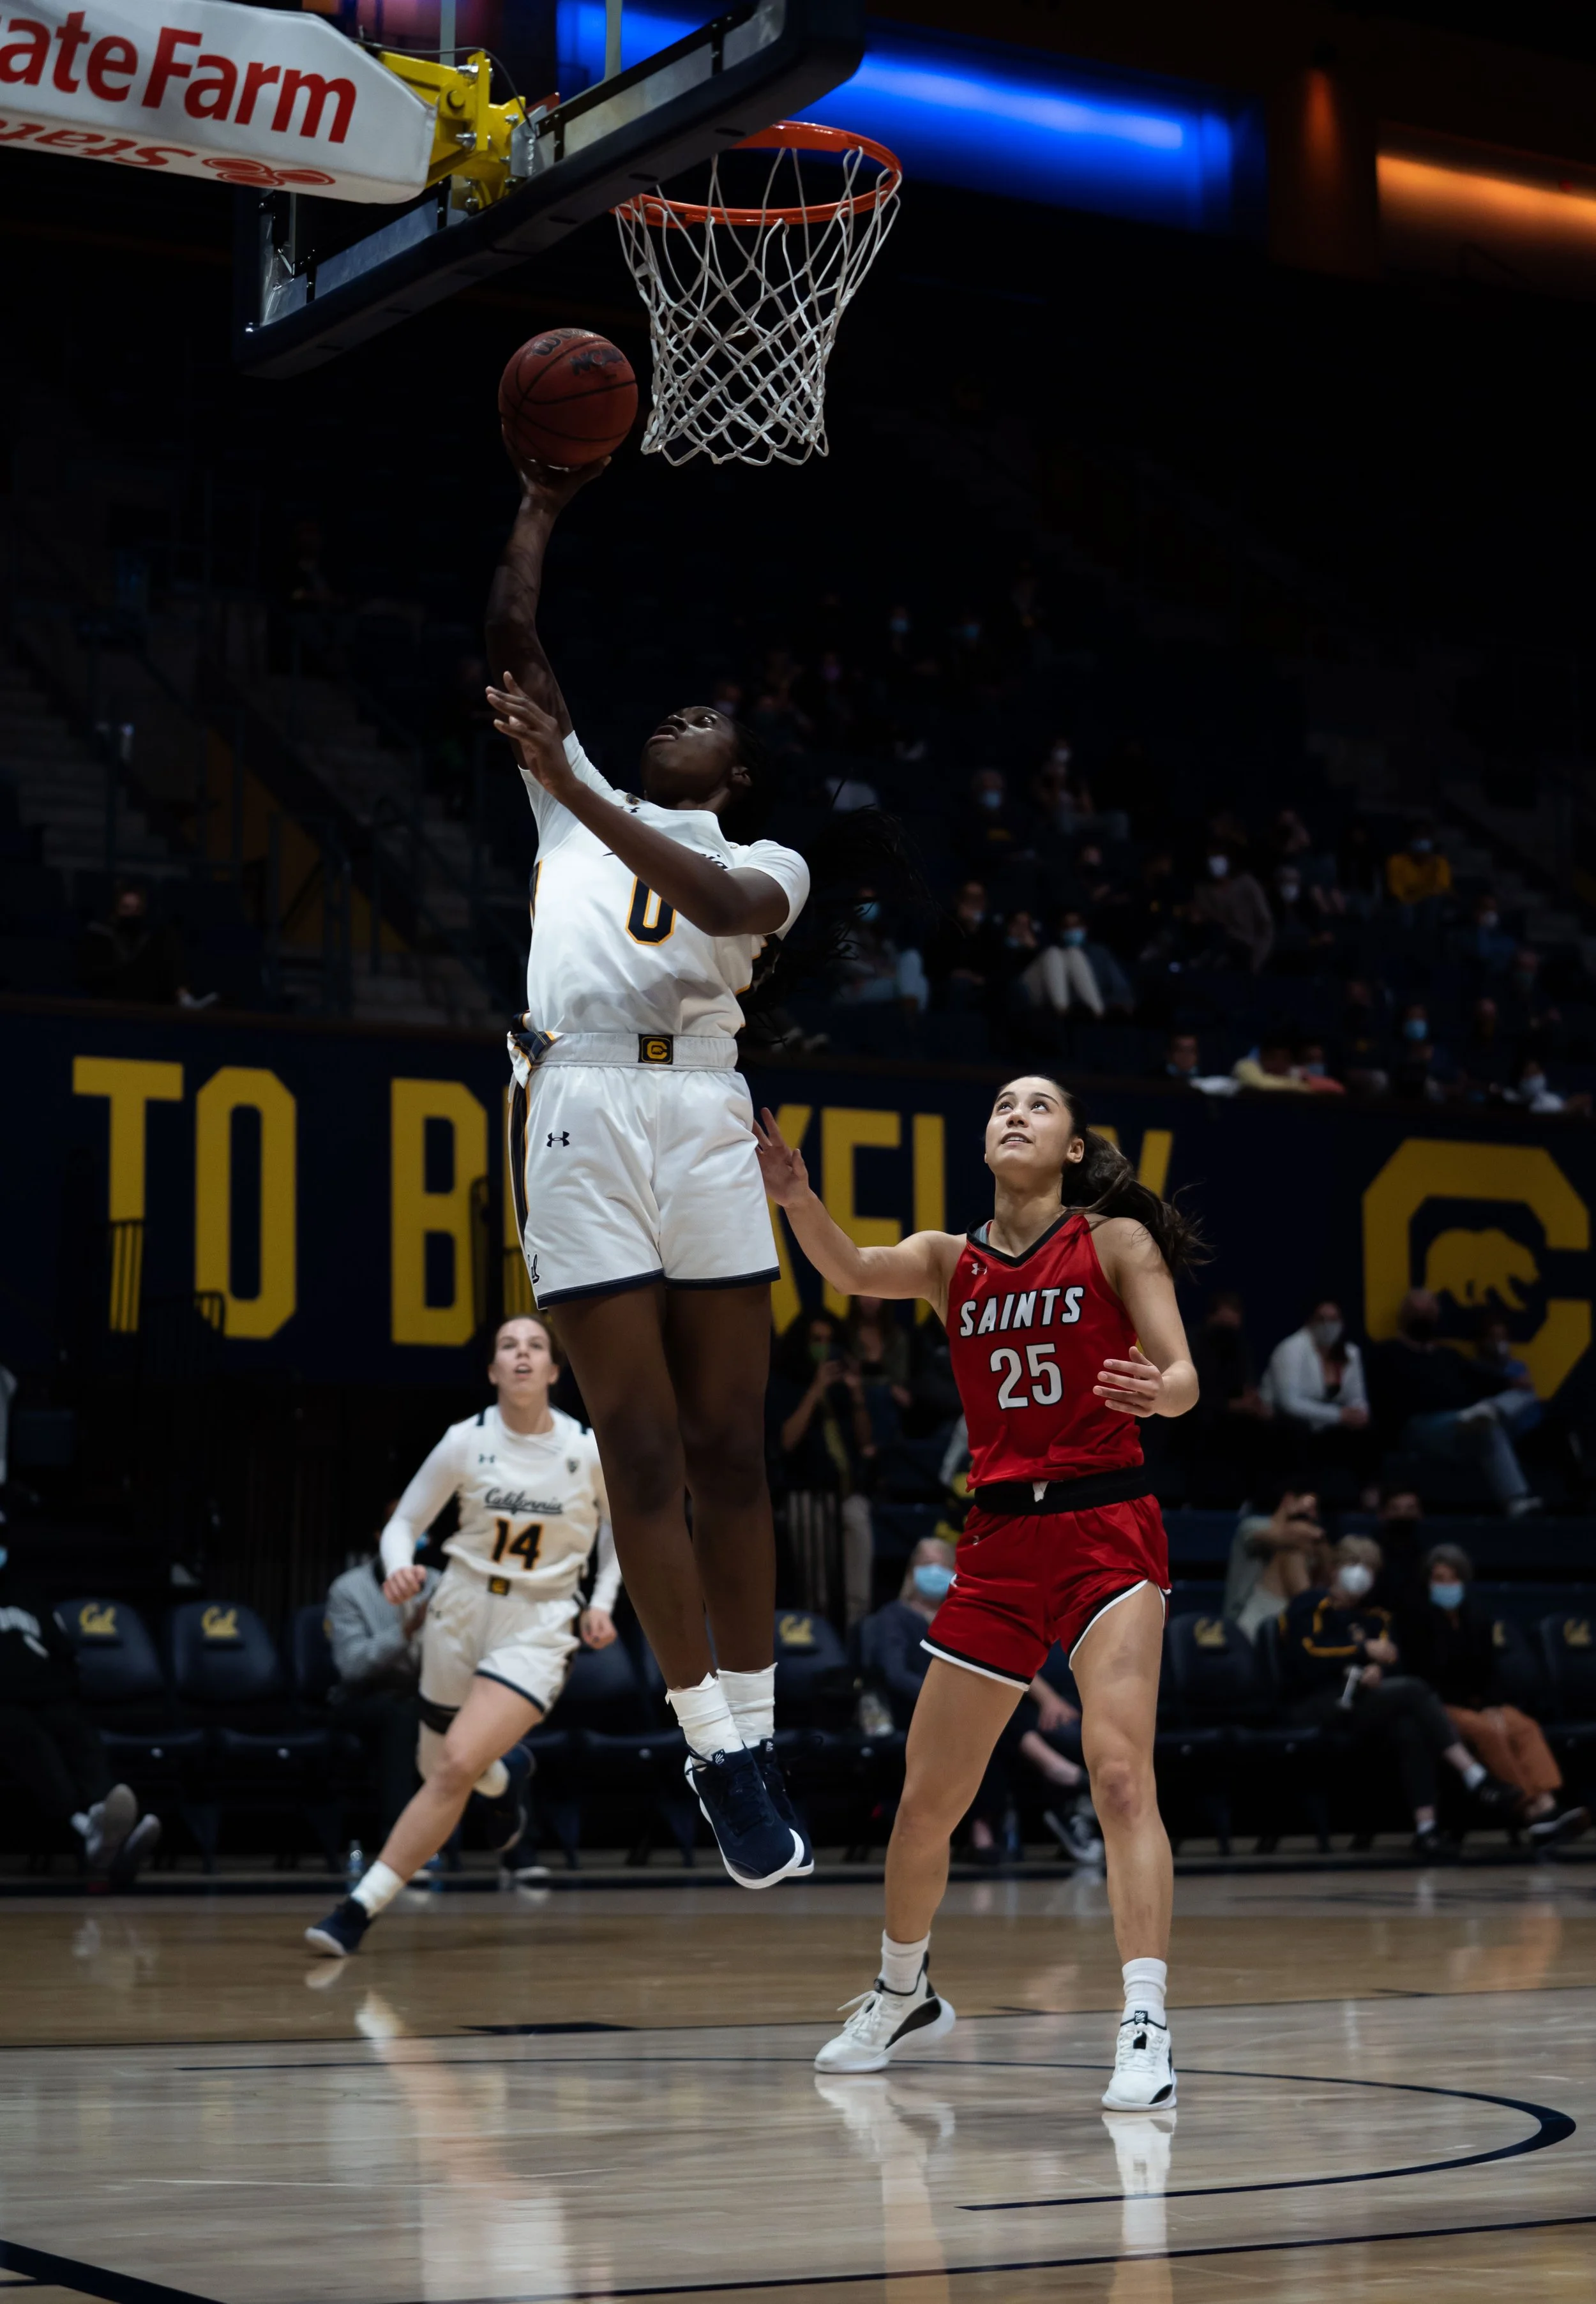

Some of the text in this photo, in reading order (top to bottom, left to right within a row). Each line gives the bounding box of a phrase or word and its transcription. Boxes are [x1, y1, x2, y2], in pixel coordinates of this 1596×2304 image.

[0, 11, 356, 143] ateFarm
[0, 120, 197, 167] Stat
[625, 875, 677, 946] 0
[72, 1055, 297, 1341] TO
[959, 1284, 1085, 1338] SAINTS
[989, 1342, 1064, 1411] 25
[483, 1487, 563, 1516] California
[491, 1516, 543, 1570] 14
